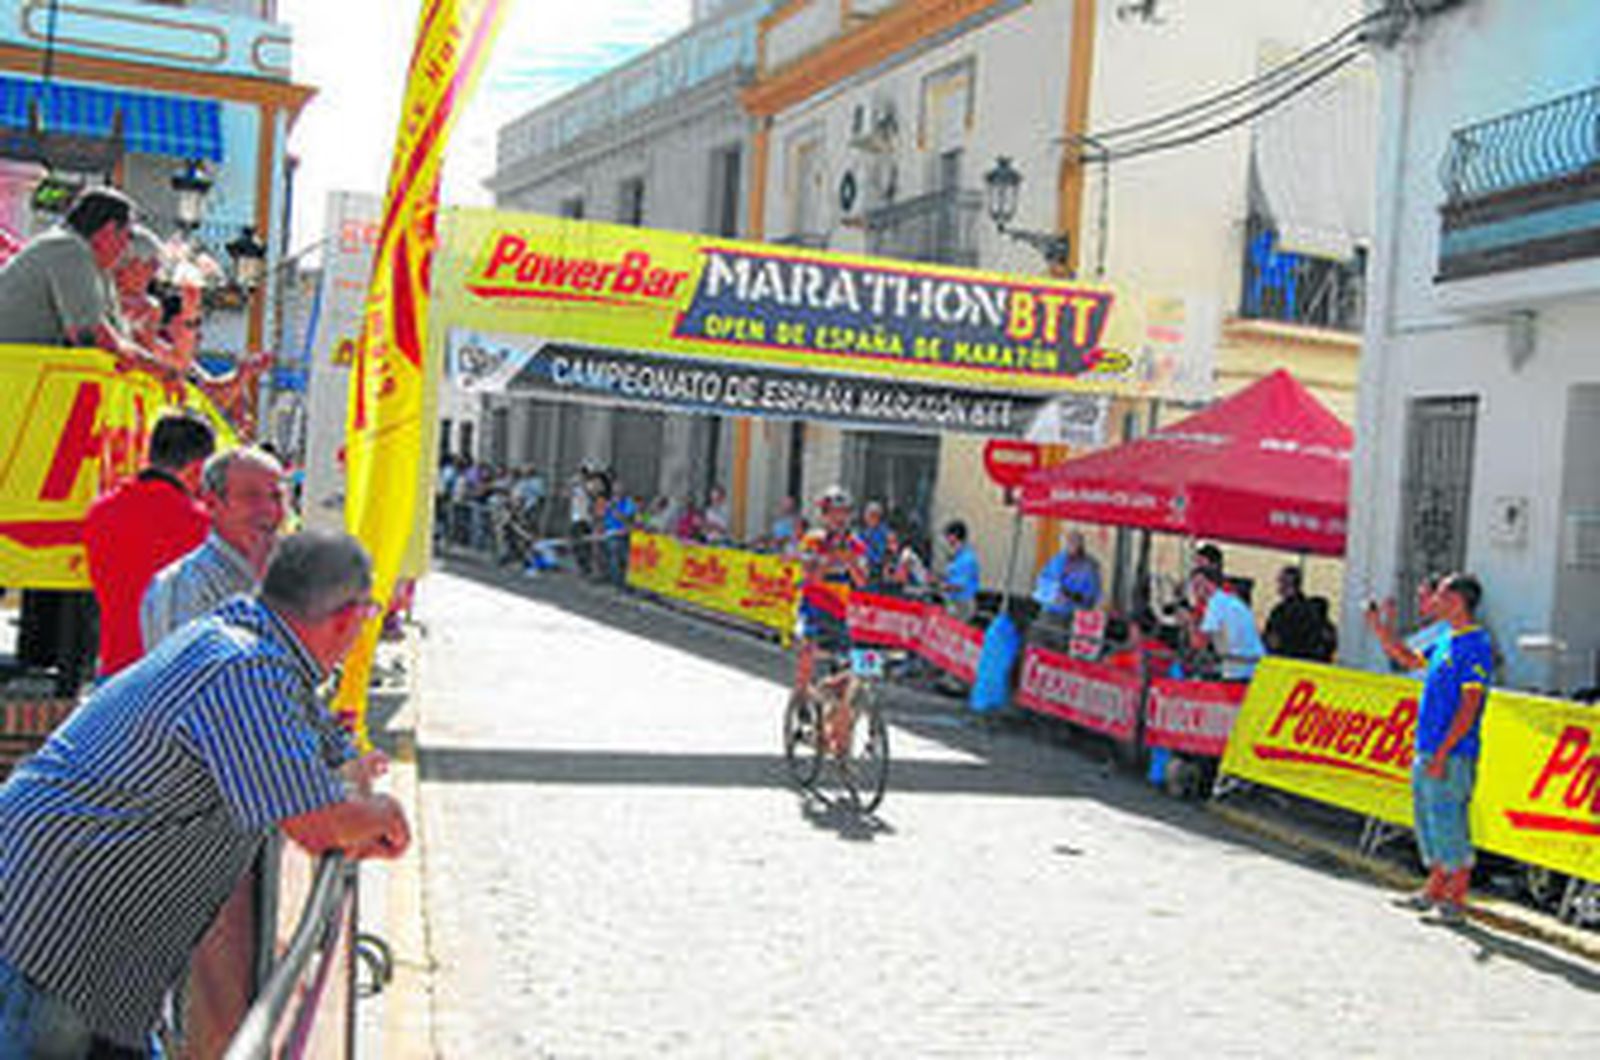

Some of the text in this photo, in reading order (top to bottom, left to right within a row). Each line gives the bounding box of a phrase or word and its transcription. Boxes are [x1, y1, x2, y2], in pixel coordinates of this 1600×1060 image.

[482, 234, 690, 299] PowerBar
[704, 314, 765, 341] OPEN
[778, 321, 806, 344] DE
[814, 325, 903, 353] ESPAÑA
[913, 337, 940, 360] DE
[552, 356, 722, 402] CAMPEONATO
[726, 375, 759, 407] DE
